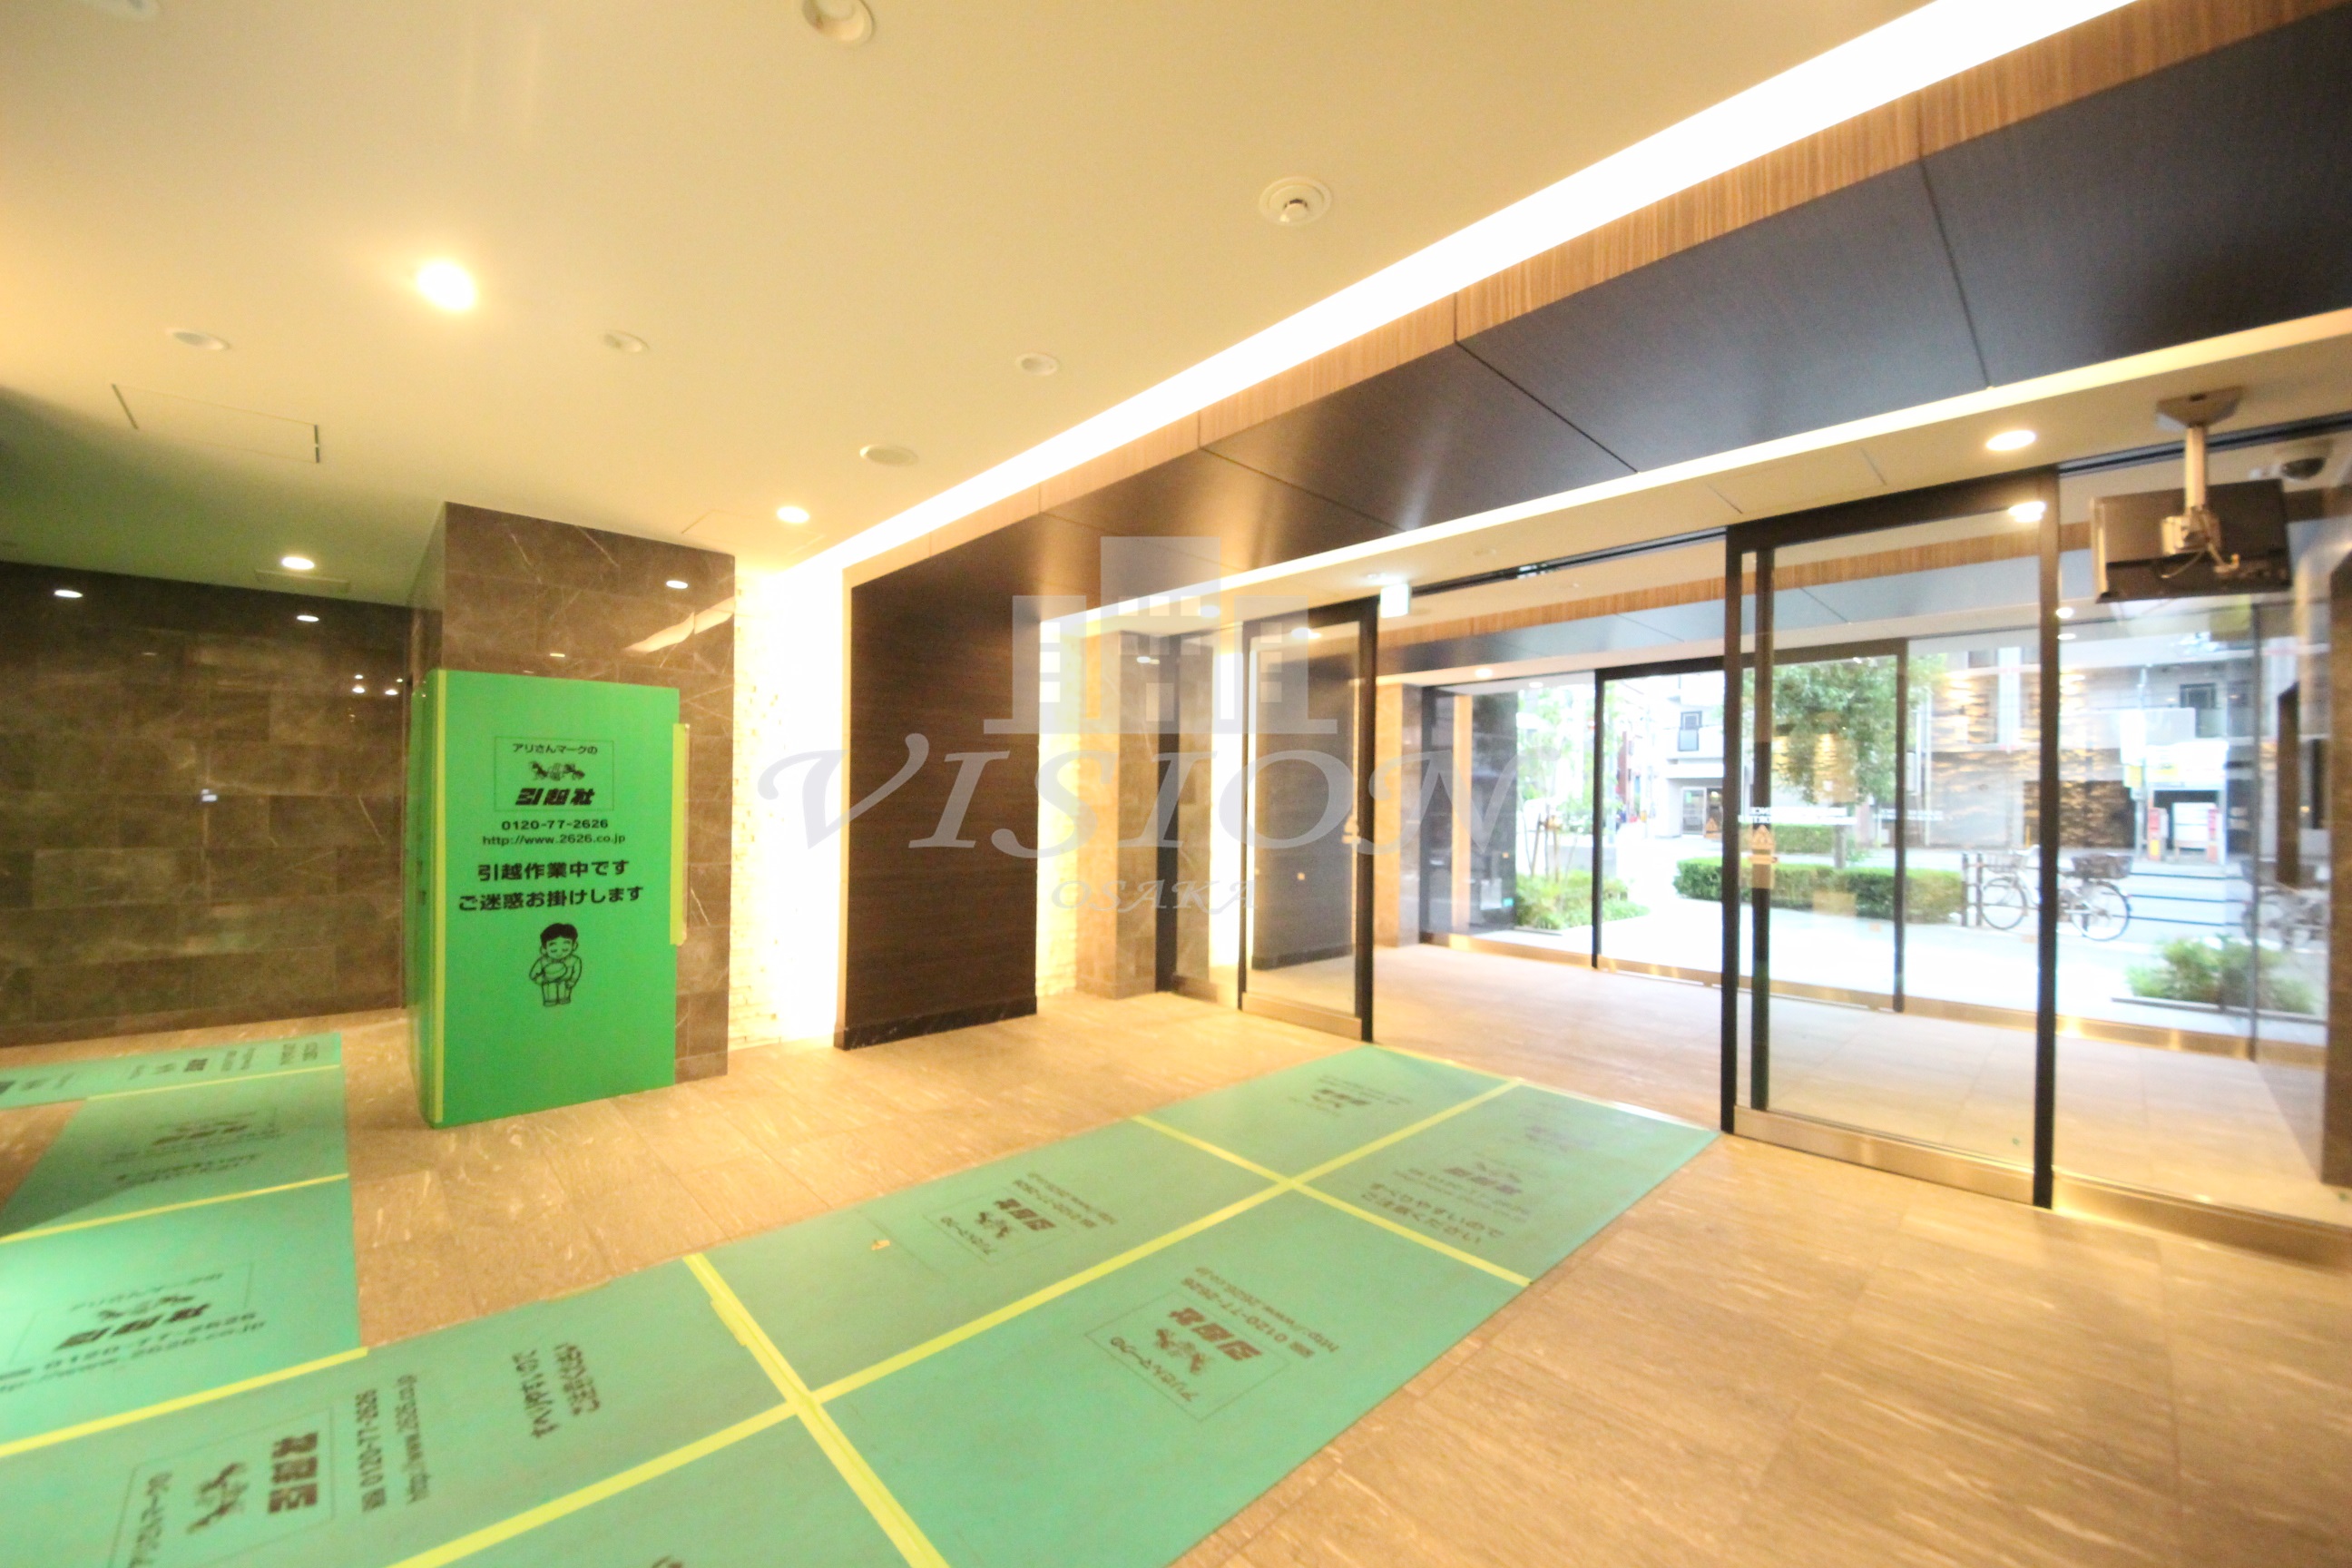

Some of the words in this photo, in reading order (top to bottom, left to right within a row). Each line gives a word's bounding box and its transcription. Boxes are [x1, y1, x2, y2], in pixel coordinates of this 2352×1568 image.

[512, 742, 599, 755] アリさんマークの
[501, 818, 609, 831] 0120-77-2626
[482, 833, 626, 847] http://www.2626.co.jp
[477, 859, 630, 882] 引越作業中です
[458, 886, 644, 911] ご迷惑お掛けします
